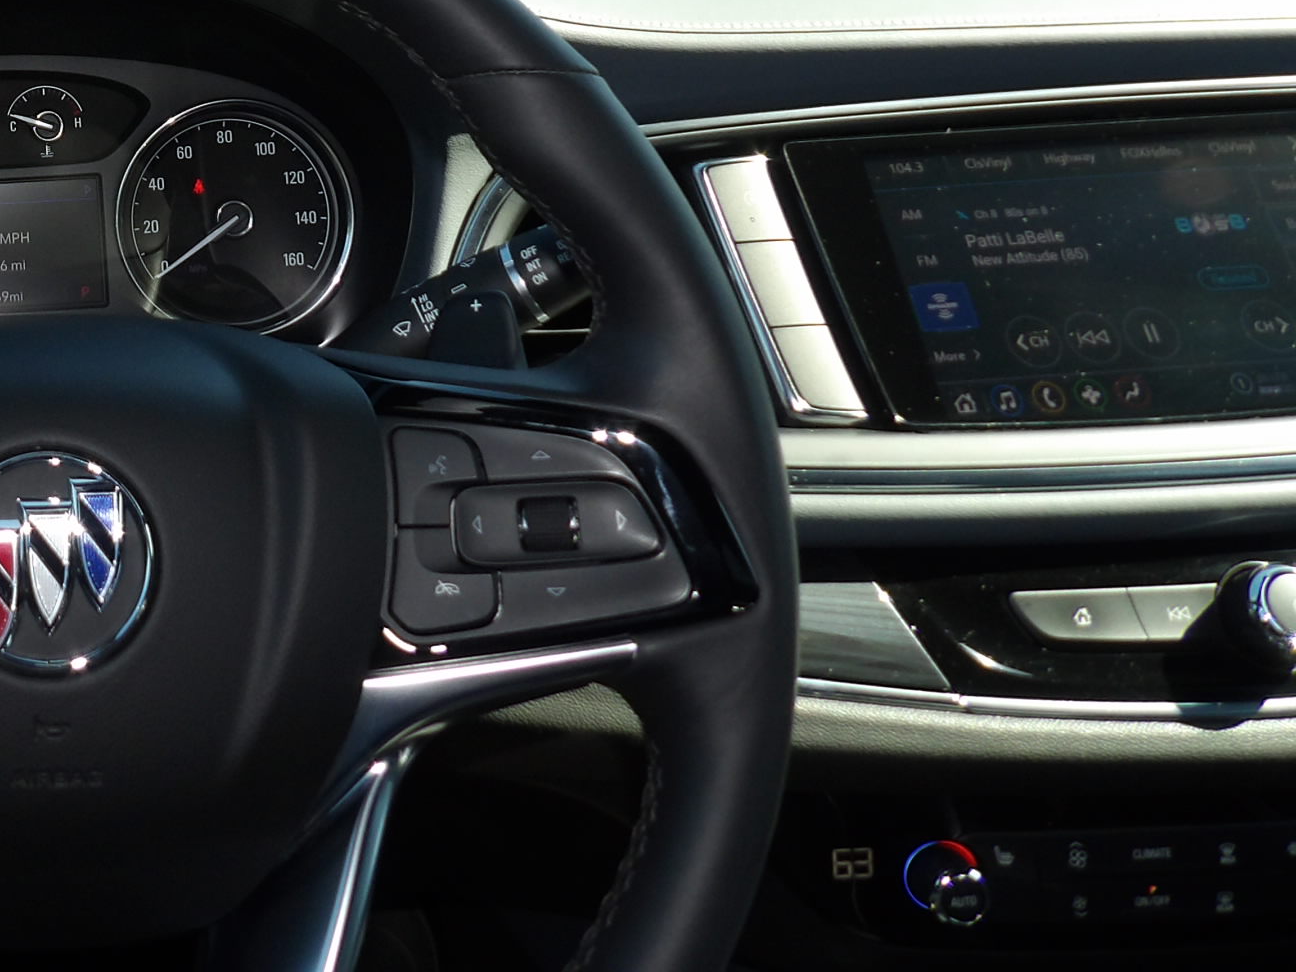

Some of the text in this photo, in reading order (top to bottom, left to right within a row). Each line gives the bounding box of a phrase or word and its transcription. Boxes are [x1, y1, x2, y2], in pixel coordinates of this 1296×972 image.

[9, 120, 17, 132] C
[74, 117, 82, 128] H
[216, 129, 233, 144] 80
[176, 145, 193, 160] 60
[254, 141, 276, 156] 100
[1043, 152, 1096, 167] Highway
[888, 161, 924, 174] 104.3
[148, 177, 165, 191] 40
[283, 170, 305, 185] 120
[294, 210, 317, 225] 140
[901, 209, 923, 221] AM
[143, 219, 159, 234] 20
[0, 231, 30, 245] MPH
[964, 228, 1065, 248] Patti LaBelle
[283, 252, 305, 267] 160
[519, 245, 538, 260] OFF
[971, 254, 1002, 267] New
[1006, 250, 1058, 265] Attitude
[11, 259, 27, 272] mi
[160, 260, 169, 272] 0
[524, 258, 542, 273] INT
[916, 254, 939, 267] FM
[531, 272, 549, 286] ON
[417, 293, 429, 304] HI
[421, 301, 434, 313] LO
[424, 309, 440, 324] INT
[1029, 334, 1050, 348] CH
[933, 351, 966, 364] More
